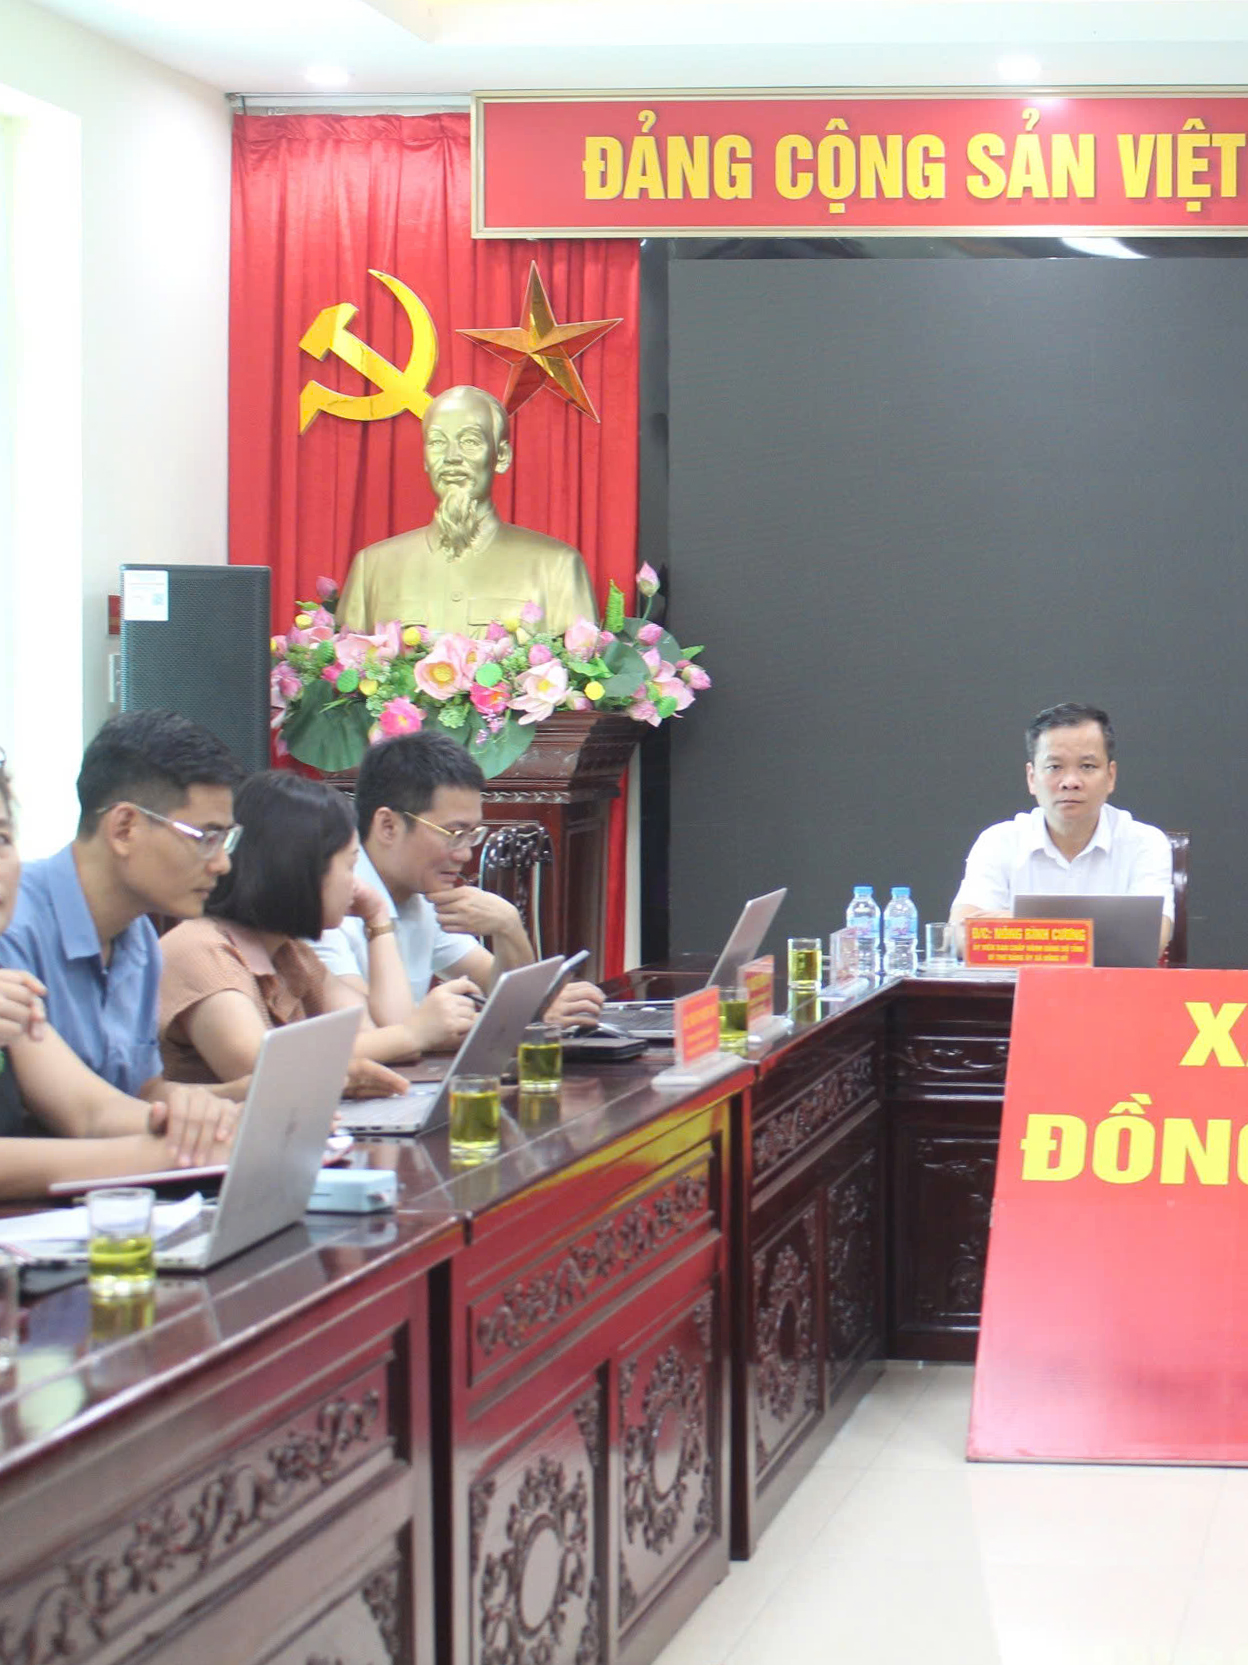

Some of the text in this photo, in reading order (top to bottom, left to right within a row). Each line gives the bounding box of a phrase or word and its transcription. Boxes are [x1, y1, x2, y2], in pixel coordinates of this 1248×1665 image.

[581, 110, 753, 200] ĐẢNG
[774, 118, 946, 214] CỘNG
[965, 108, 1096, 200] SẢN
[1116, 118, 1246, 213] VIỆT
